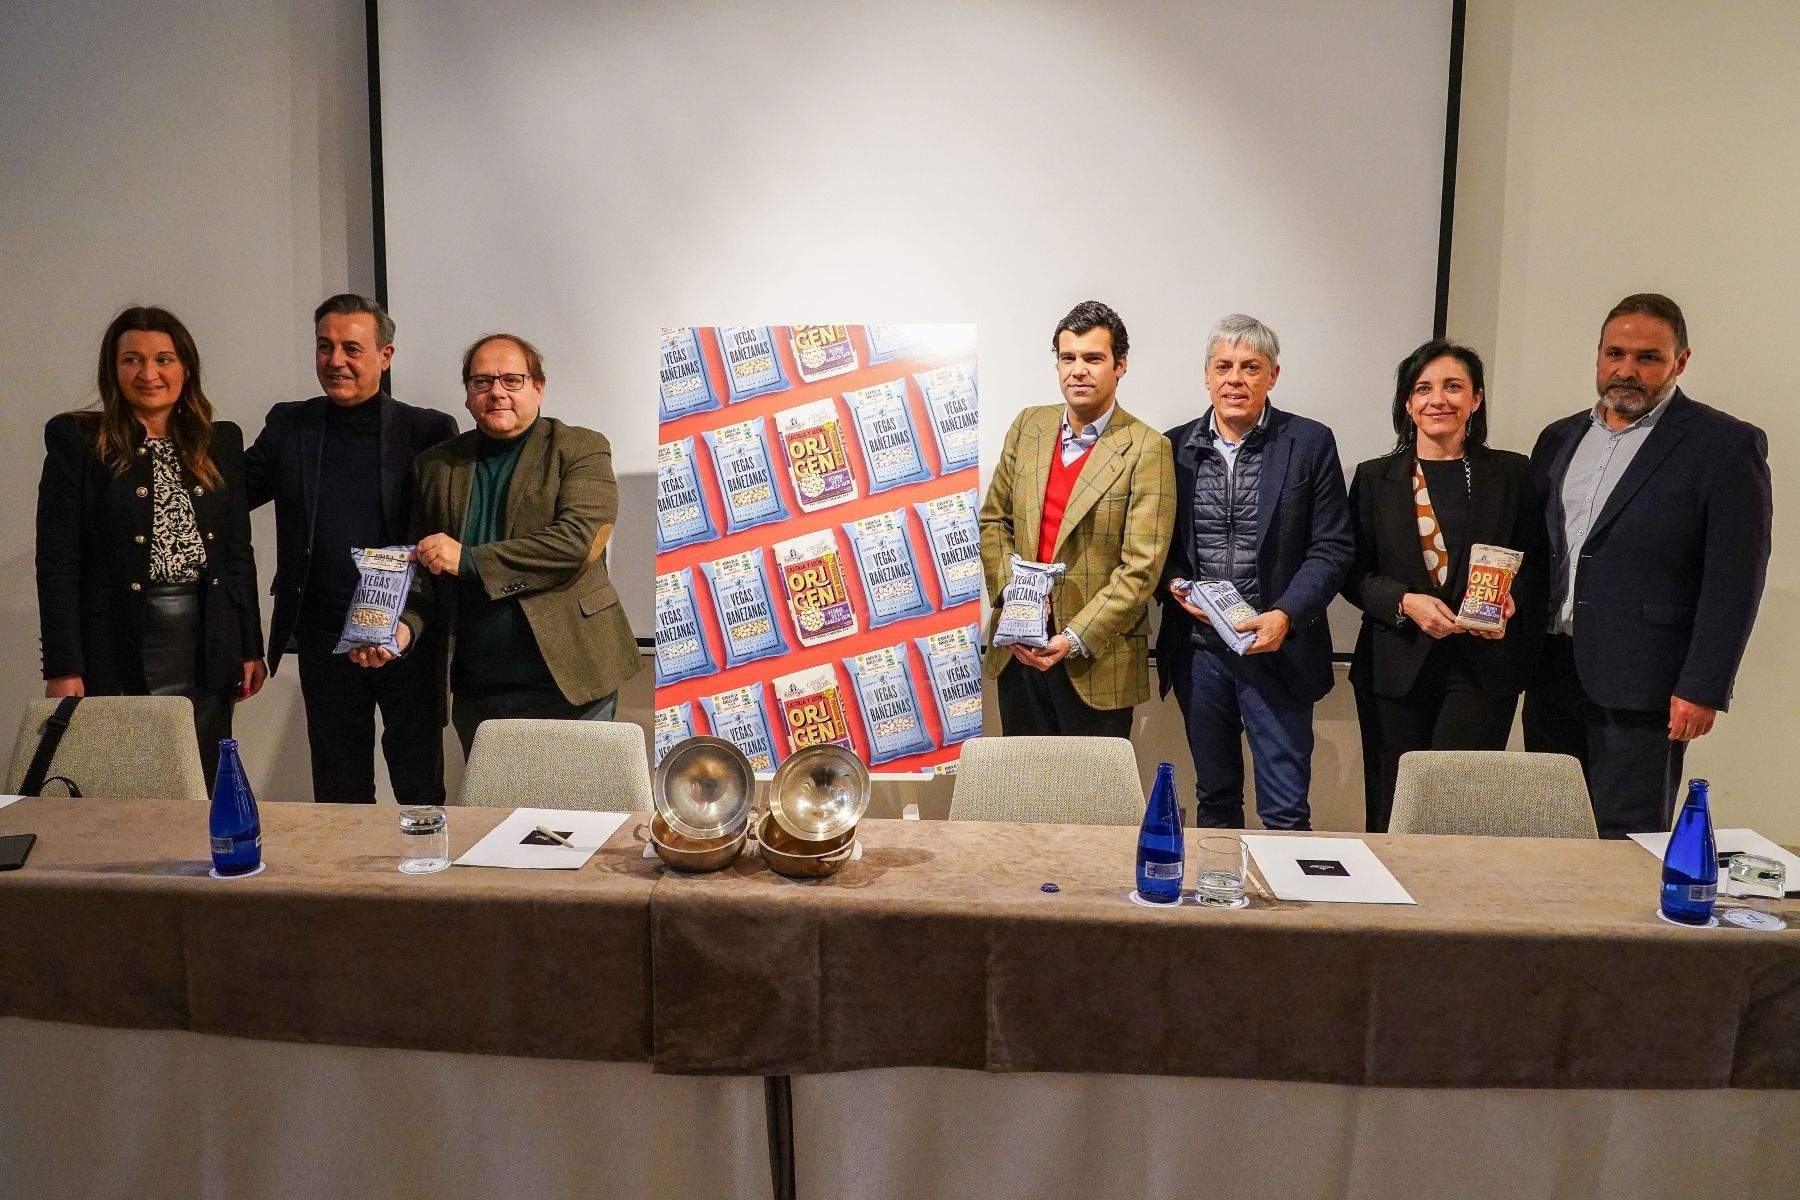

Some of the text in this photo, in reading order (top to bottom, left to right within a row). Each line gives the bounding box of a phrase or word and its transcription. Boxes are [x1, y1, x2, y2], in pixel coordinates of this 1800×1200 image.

[734, 329, 756, 346] VEGAS
[664, 348, 687, 365] VEGAS
[730, 342, 769, 363] BAÑEZANAS
[660, 361, 700, 382] BAÑEZANAS
[944, 399, 967, 415] VEGAS
[873, 418, 896, 434] VEGAS
[790, 433, 830, 459] ORI
[869, 430, 910, 452] BAÑEZANAS
[732, 457, 754, 473] VEGAS
[661, 476, 684, 493] VEGAS
[728, 469, 768, 492] BAÑEZANAS
[658, 489, 697, 512] BAÑEZANAS
[945, 530, 969, 547] VEGAS
[873, 549, 896, 566] VEGAS
[364, 574, 390, 589] VEGAS
[789, 566, 830, 592] ORI
[869, 563, 910, 585] BAÑEZANAS
[1015, 574, 1038, 586] VEGAS
[730, 589, 753, 606] VEGAS
[659, 609, 682, 626] VEGAS
[726, 602, 767, 625] BAÑEZANAS
[946, 665, 970, 683] VEGAS
[874, 684, 898, 702] VEGAS
[789, 700, 831, 727] ORI
[870, 698, 911, 722] BAÑEZANAS
[730, 724, 753, 741] VEGAS
